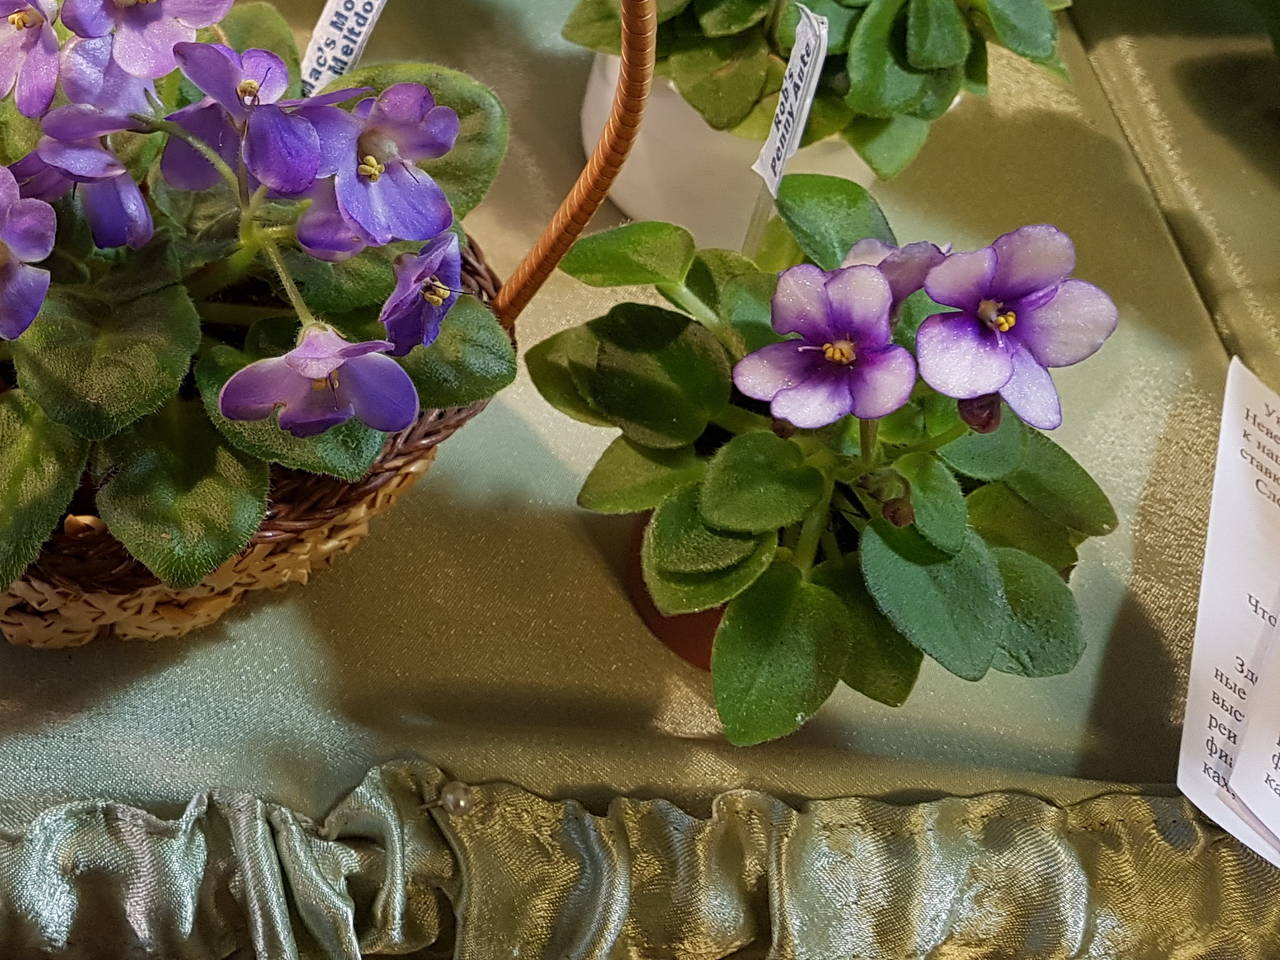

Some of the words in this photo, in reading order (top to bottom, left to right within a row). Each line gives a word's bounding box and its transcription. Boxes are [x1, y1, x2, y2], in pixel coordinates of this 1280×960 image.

[770, 103, 795, 178] Penny
[793, 42, 812, 102] Ante
[773, 67, 794, 132] Rob's
